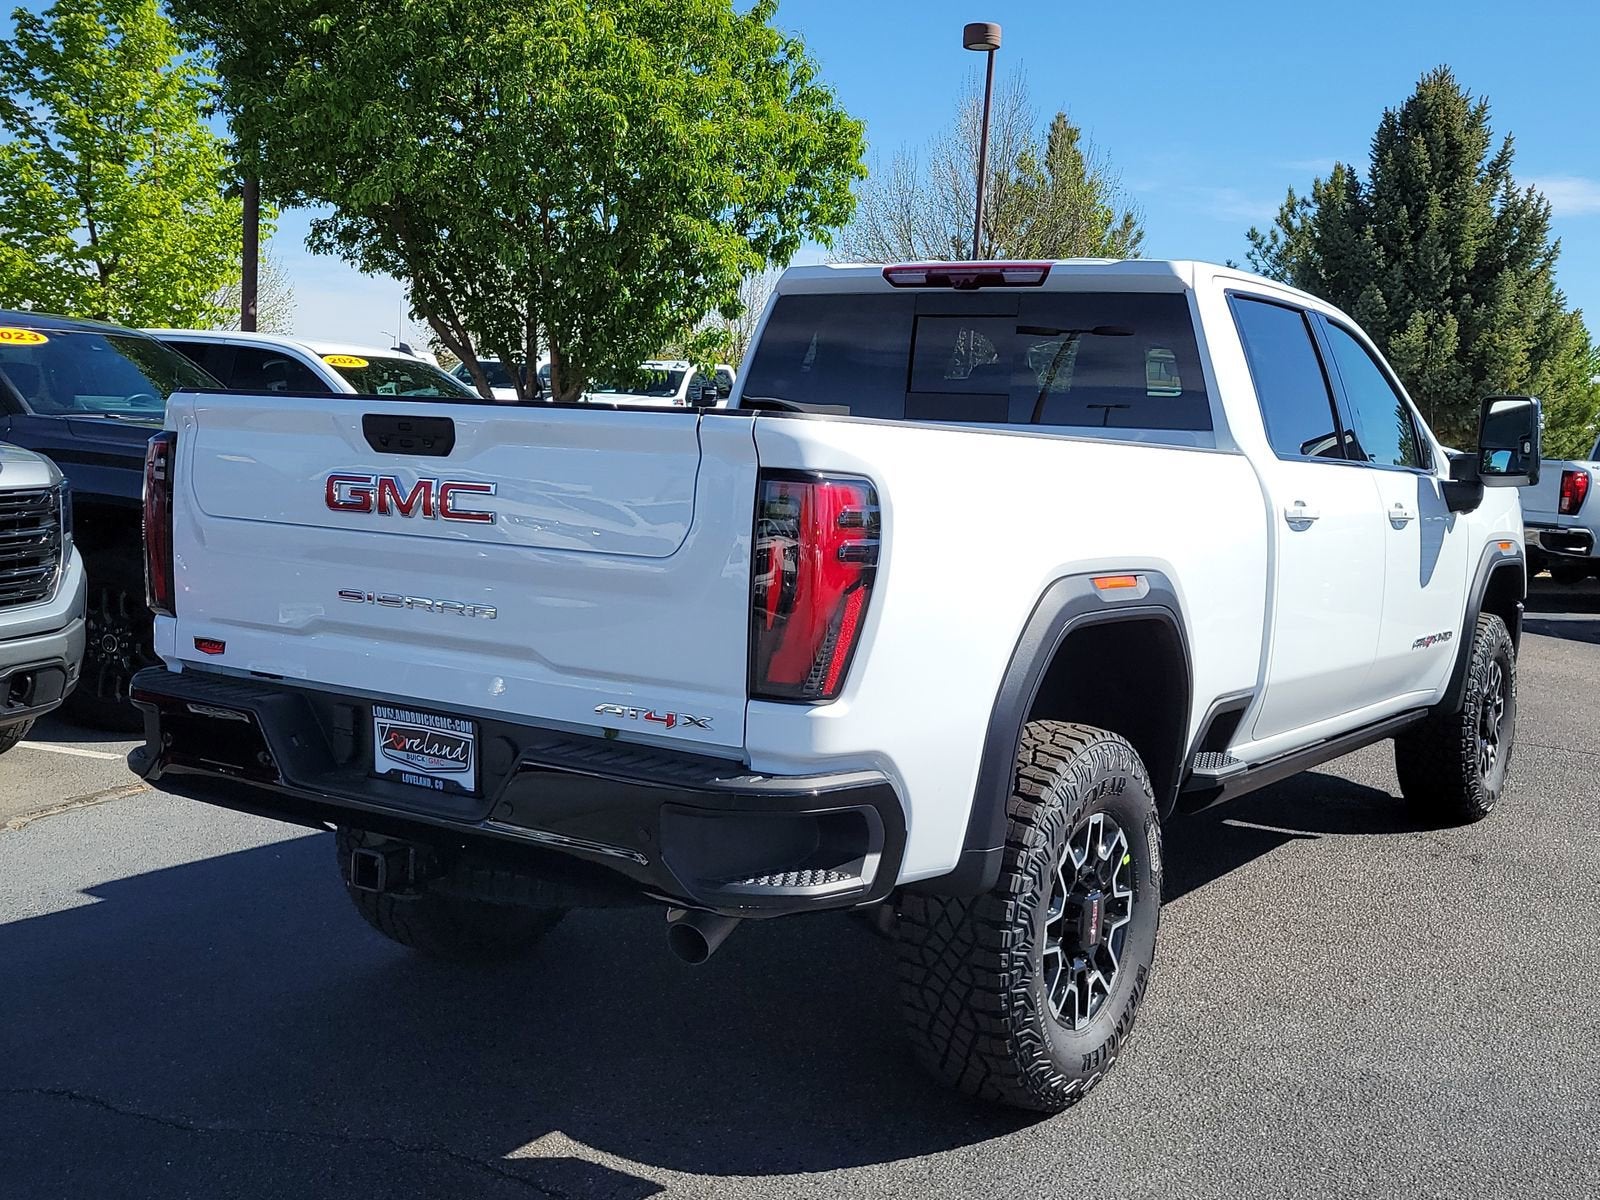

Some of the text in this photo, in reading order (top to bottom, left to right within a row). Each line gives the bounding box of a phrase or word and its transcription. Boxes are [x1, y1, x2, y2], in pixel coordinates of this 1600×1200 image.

[0, 331, 41, 342] 023
[325, 472, 498, 525] GMC
[337, 588, 498, 620] SIERRA
[406, 753, 445, 767] BUICK GMC
[434, 779, 444, 790] CO
